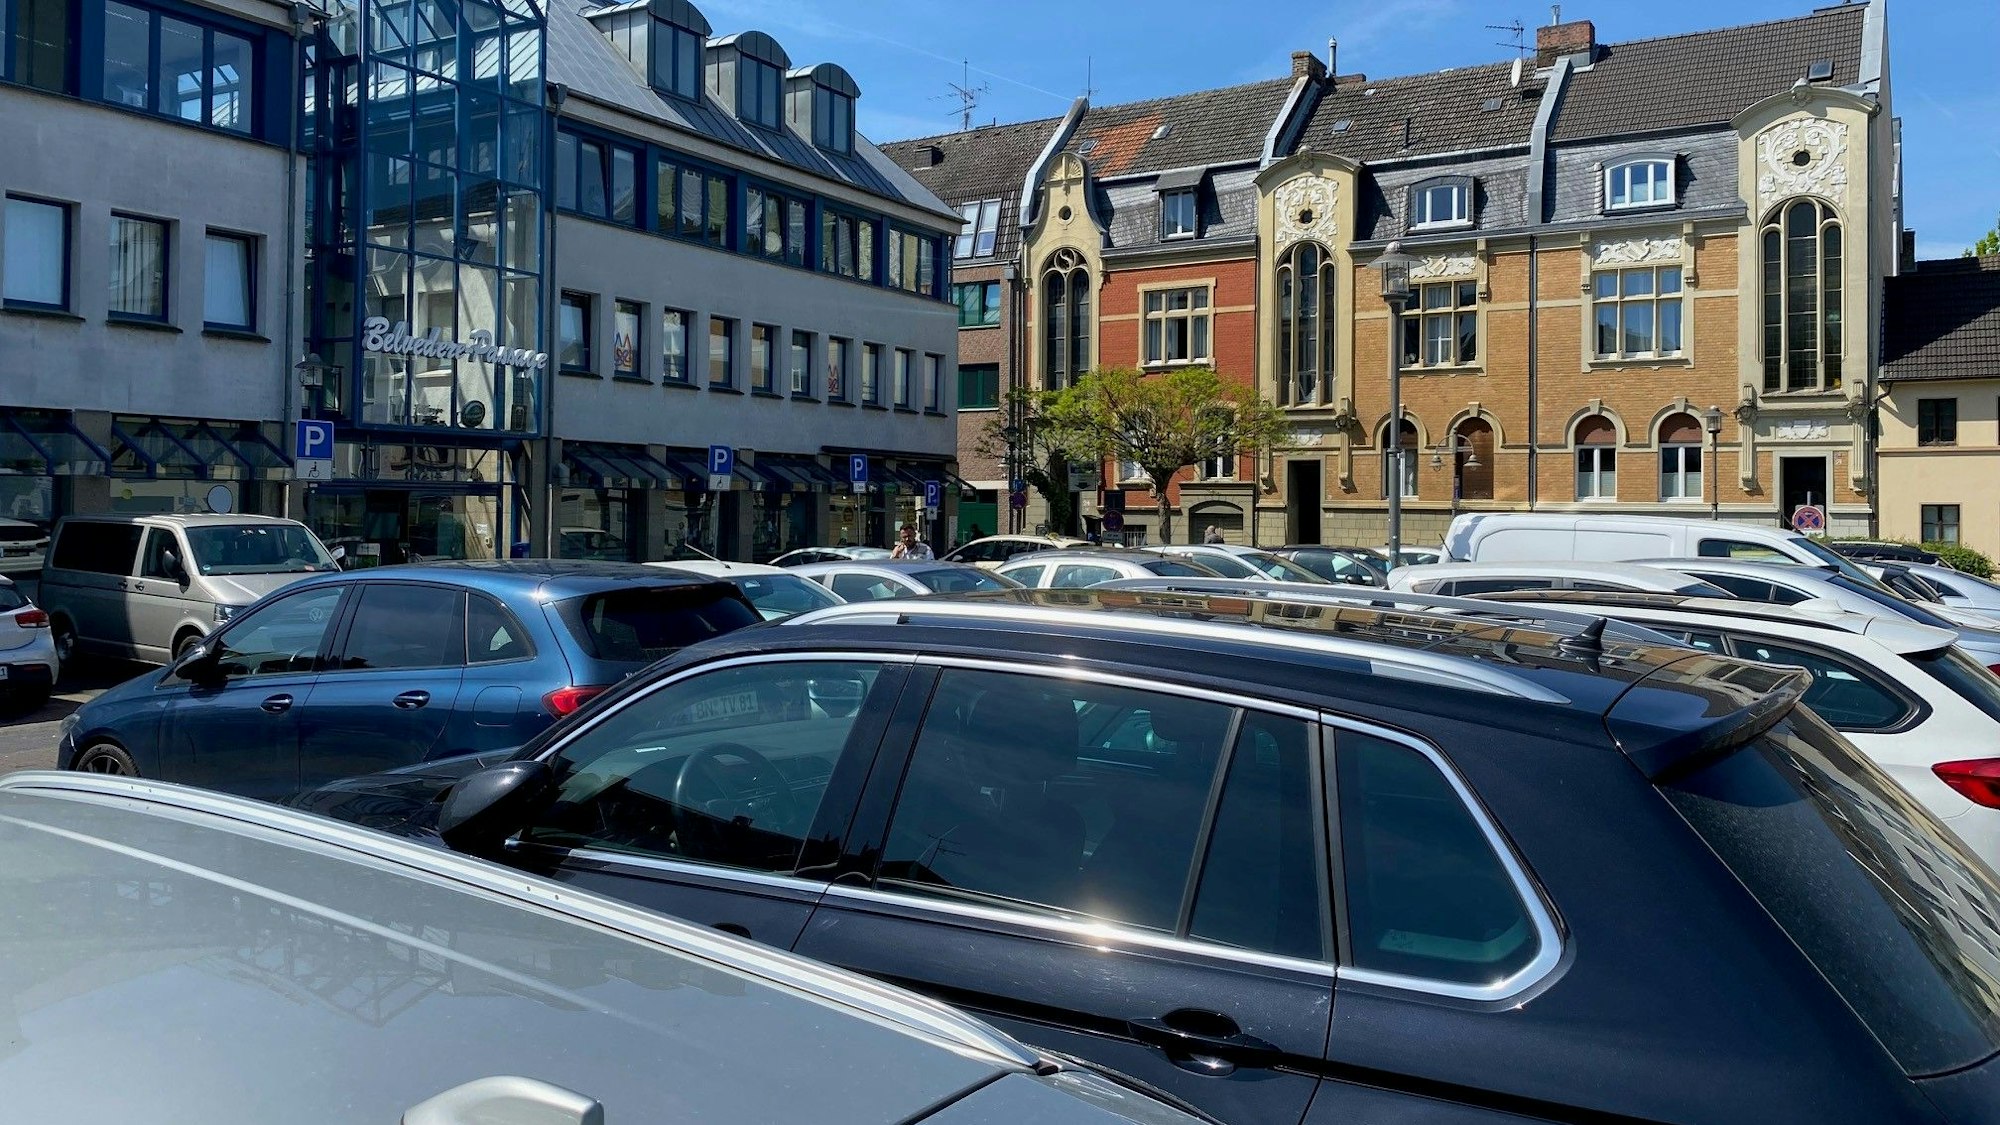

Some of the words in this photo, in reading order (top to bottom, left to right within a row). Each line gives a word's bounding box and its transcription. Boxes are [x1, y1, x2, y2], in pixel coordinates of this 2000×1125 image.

[305, 425, 325, 456] P
[714, 448, 728, 472] P
[853, 458, 864, 479] P
[927, 484, 937, 504] P
